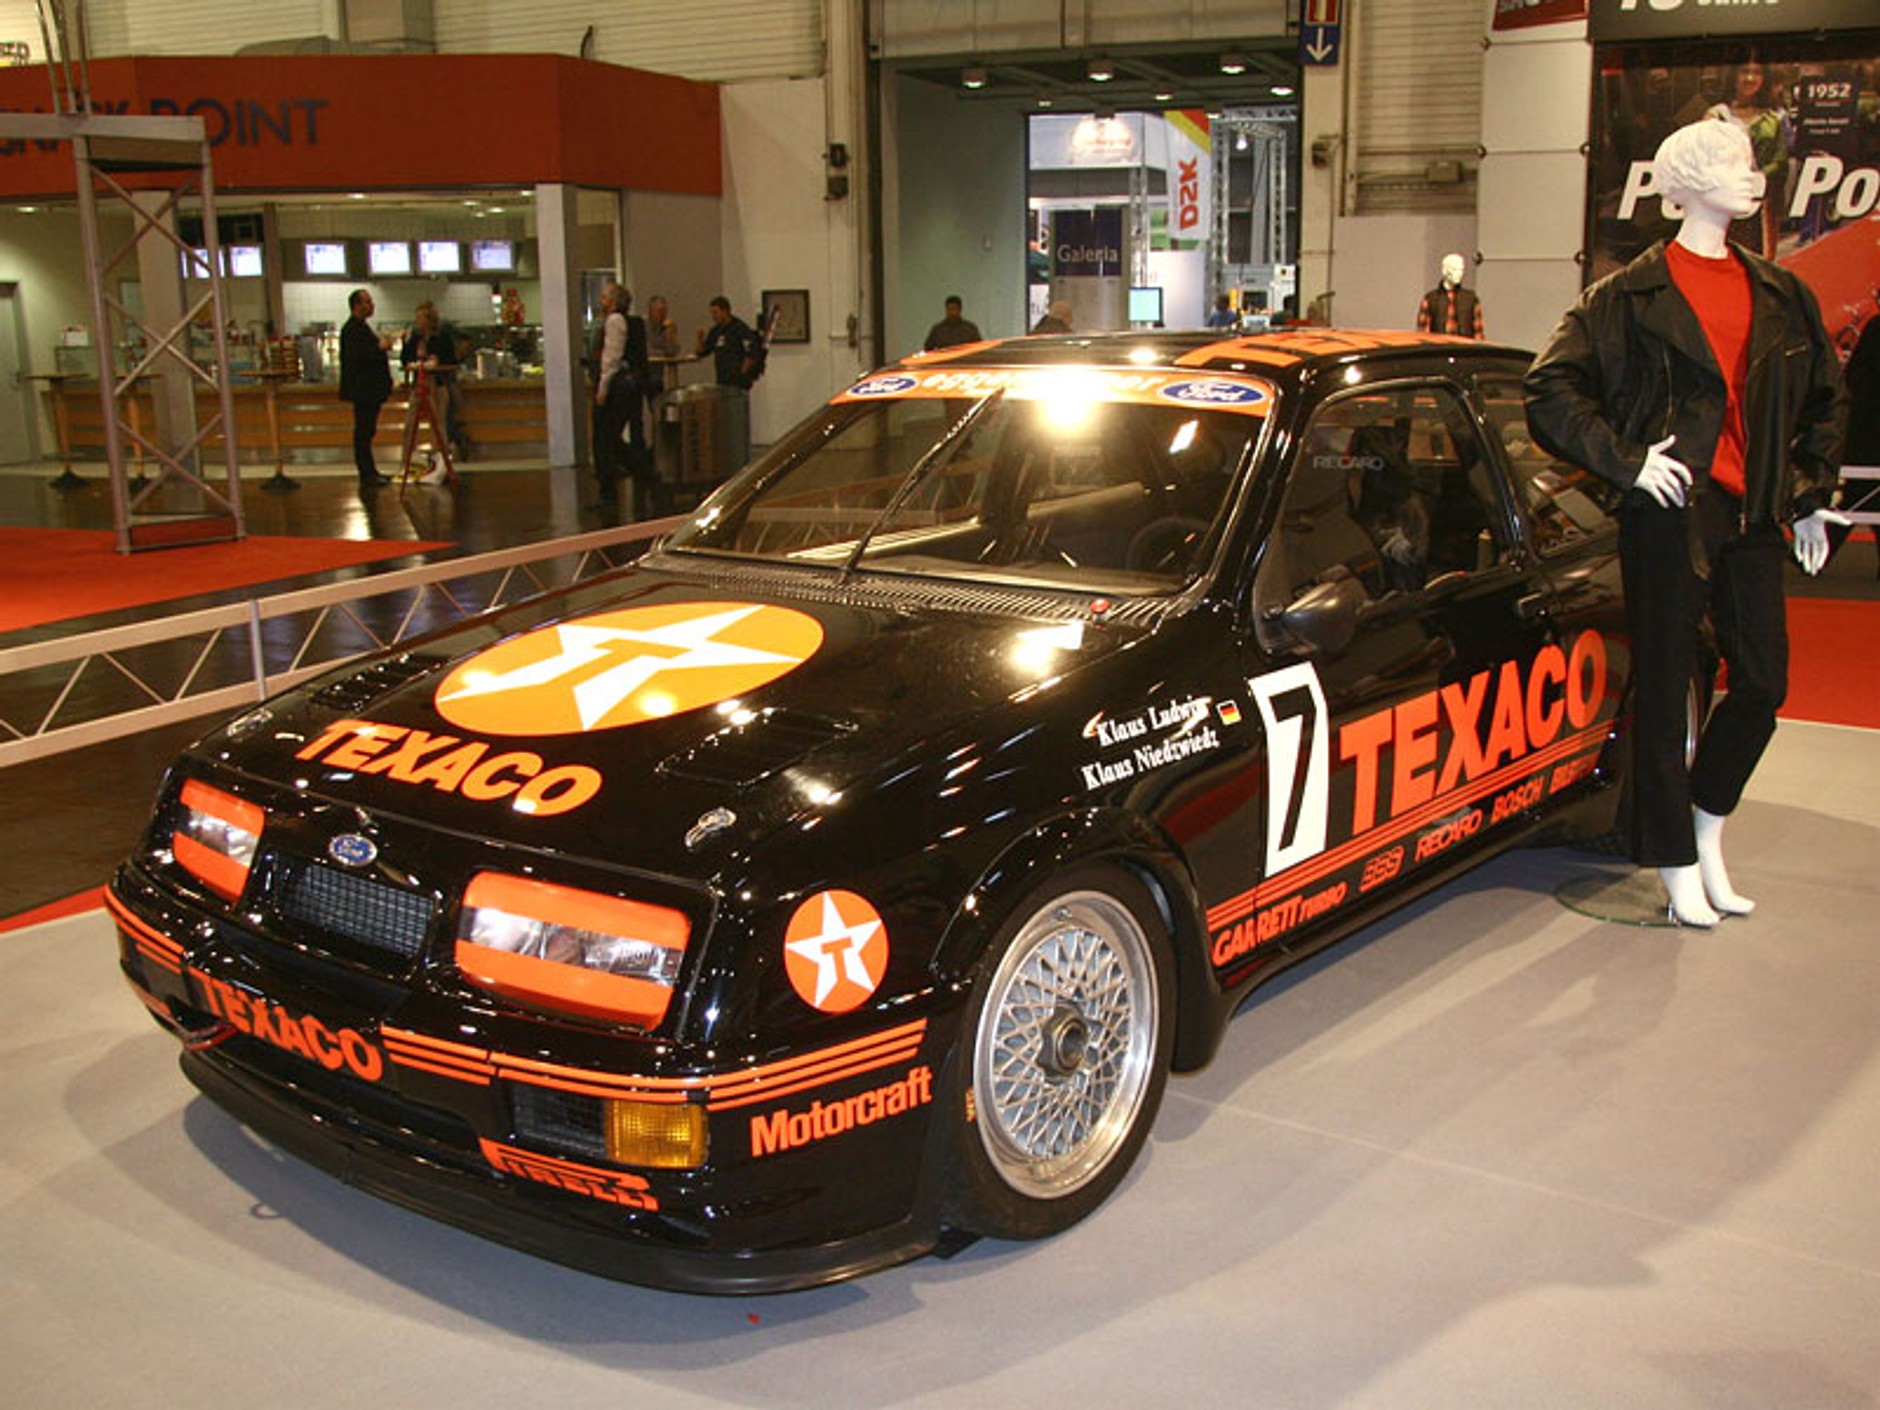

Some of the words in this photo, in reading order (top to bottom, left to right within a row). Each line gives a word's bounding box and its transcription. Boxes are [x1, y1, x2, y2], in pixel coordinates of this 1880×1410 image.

[1808, 82, 1851, 98] 1952
[1056, 244, 1118, 263] Galeria
[1177, 381, 1248, 400] Ford
[1313, 455, 1385, 472] RECARO
[295, 719, 602, 816] TEXACO
[1081, 760, 1135, 791] Klaus
[1133, 726, 1221, 772] Niedzwiedz
[1096, 717, 1148, 747] Klaus
[1268, 684, 1318, 851] 7
[1340, 629, 1607, 835] TEXACO
[1414, 808, 1483, 863] RECARO
[1490, 774, 1545, 824] BOSCH
[188, 966, 382, 1082] TEXACO
[750, 1066, 932, 1158] Motorcraft
